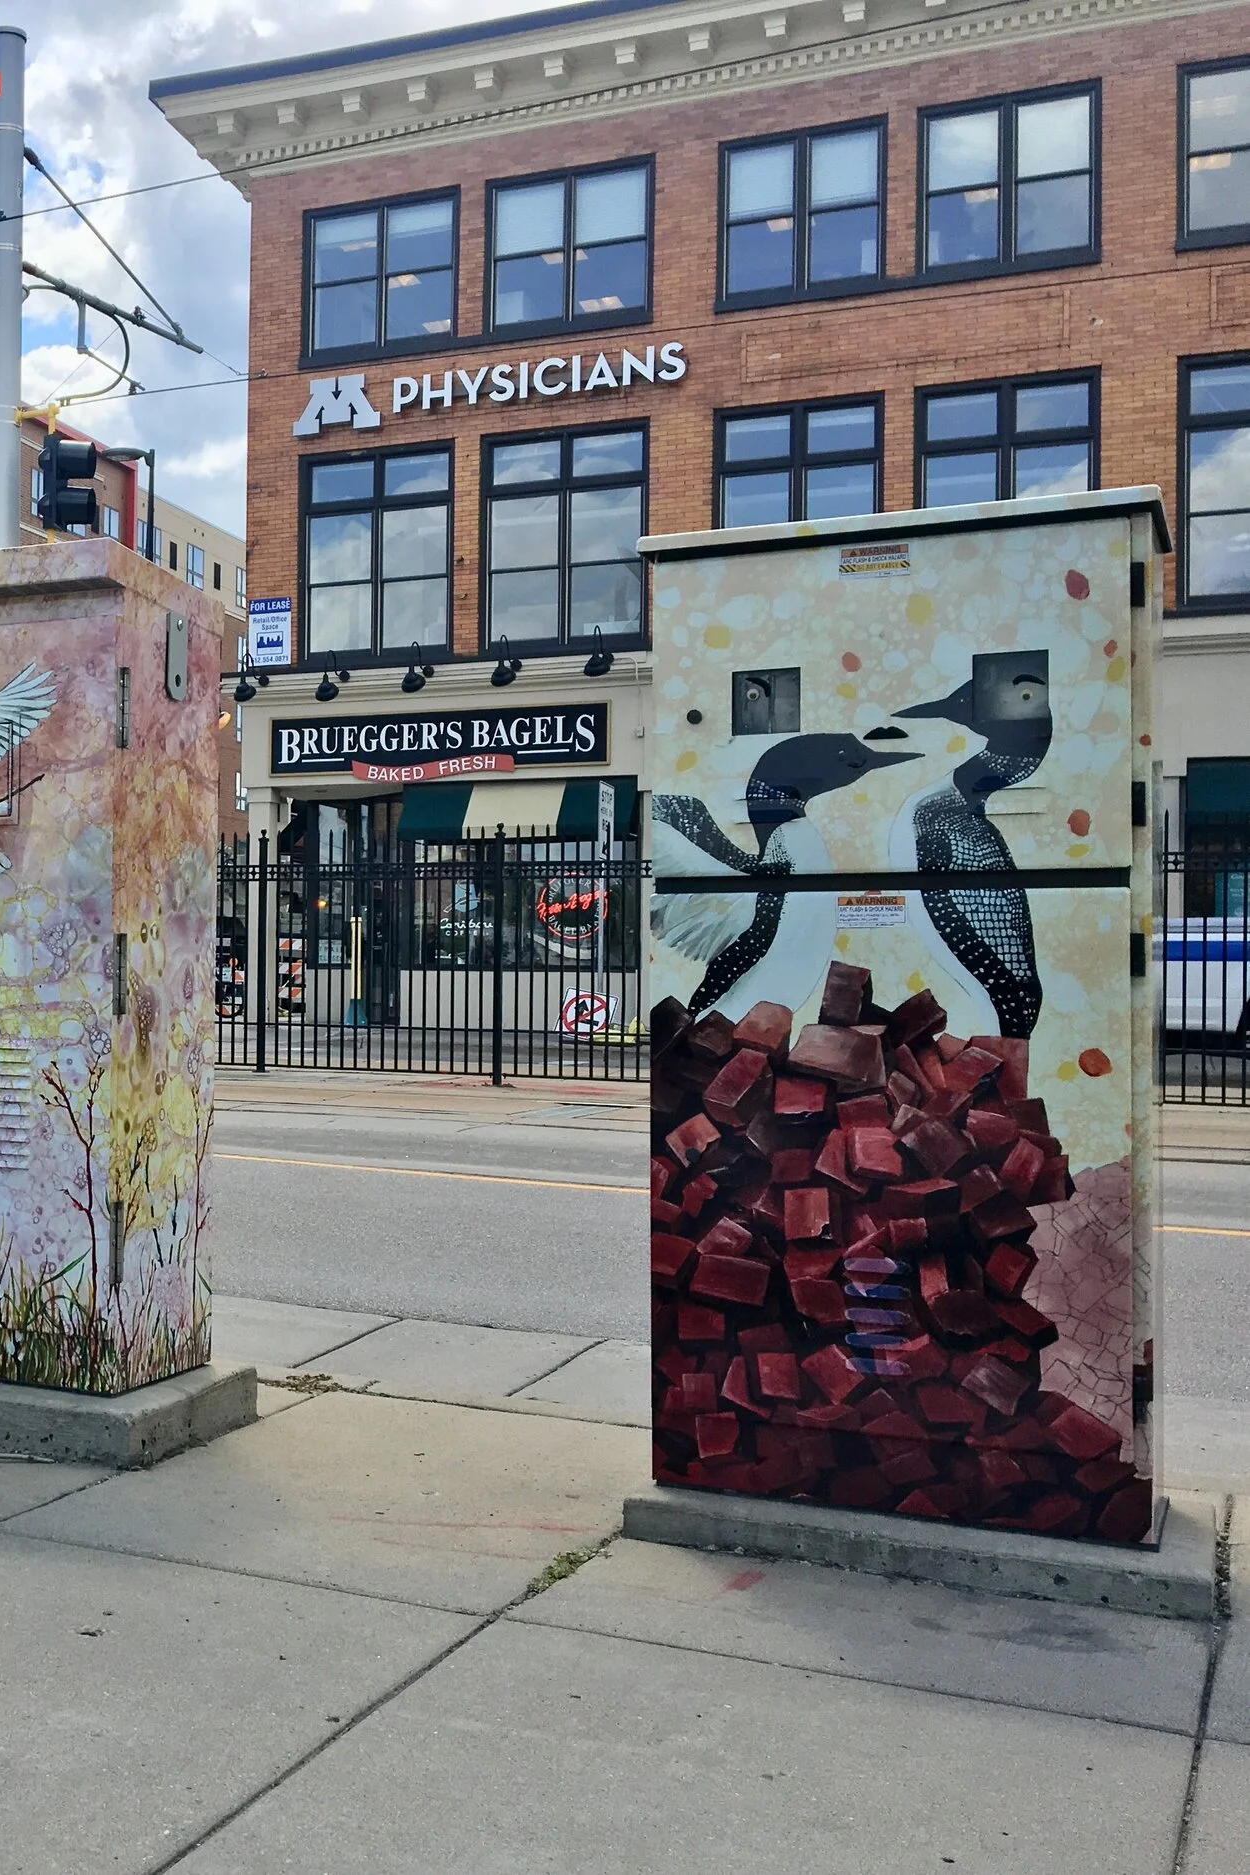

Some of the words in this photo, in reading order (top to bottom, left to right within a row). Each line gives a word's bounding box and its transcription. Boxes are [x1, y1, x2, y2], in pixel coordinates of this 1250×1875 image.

[392, 341, 688, 413] PHYSICIANS
[859, 545, 901, 556] WARNING
[250, 602, 266, 612] FOR
[268, 600, 290, 610] LEASE
[278, 720, 463, 765] BRUEGGER'S
[470, 713, 596, 753] BAGELS
[367, 765, 424, 781] BAKED
[438, 756, 497, 775] FRESH
[856, 896, 898, 905] WARNING
